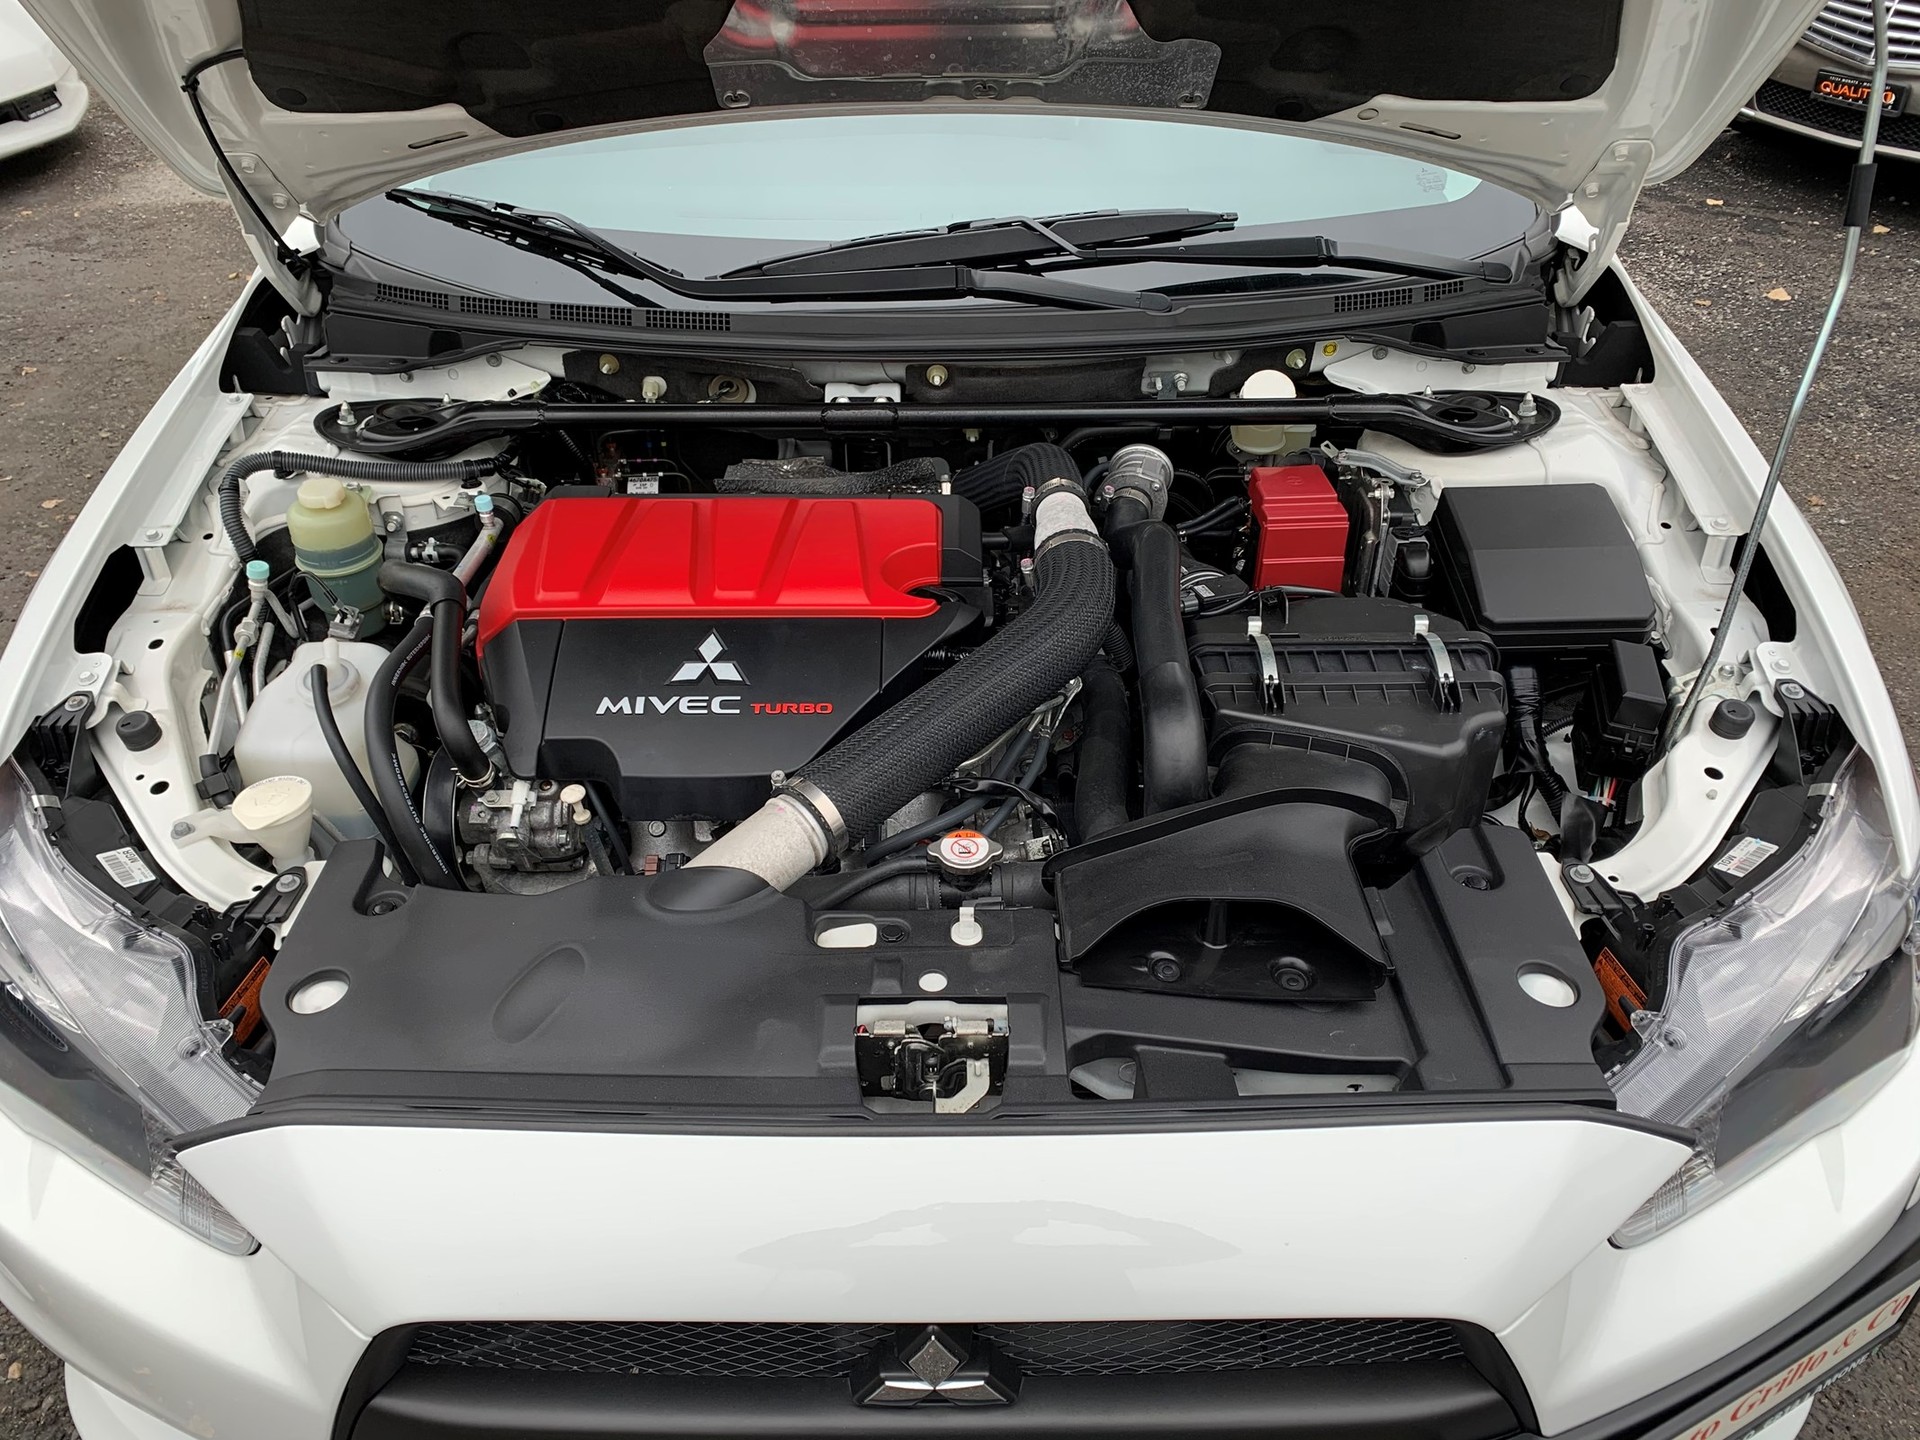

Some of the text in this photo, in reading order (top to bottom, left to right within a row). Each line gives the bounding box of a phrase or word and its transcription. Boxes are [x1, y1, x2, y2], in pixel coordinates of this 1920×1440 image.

[596, 696, 834, 715] MIVEC TURBO
[1730, 1350, 1829, 1422] Grillo
